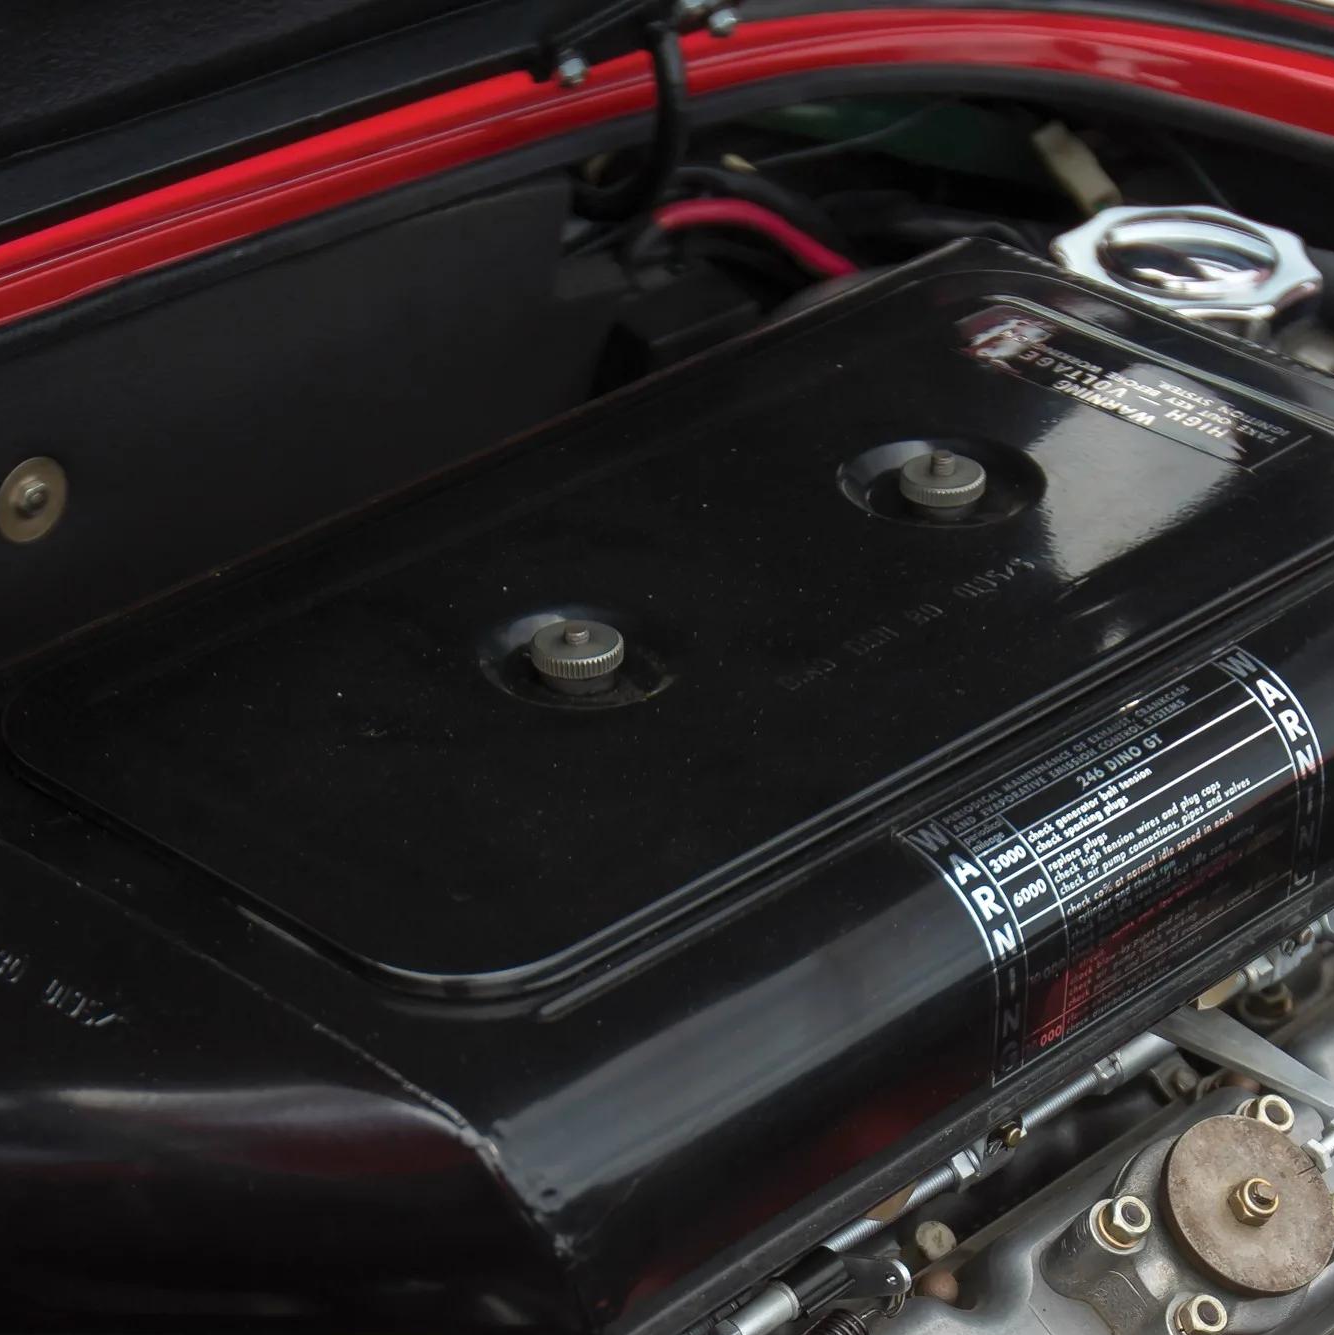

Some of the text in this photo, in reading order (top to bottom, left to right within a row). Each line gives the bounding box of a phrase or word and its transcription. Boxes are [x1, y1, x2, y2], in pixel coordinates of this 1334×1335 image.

[1019, 350, 1127, 397] VOLTAGE
[1104, 371, 1161, 397] BEFORE
[1052, 379, 1156, 426] WARNING
[1163, 398, 1195, 410] KEY
[1164, 409, 1228, 438] HIGH
[1197, 410, 1231, 424] OUT
[1217, 405, 1290, 436] IGNITION
[1236, 424, 1277, 443] TAKE
[941, 787, 1002, 826] PERIODICAL
[1002, 748, 1072, 792] MAINTENANCE
[1071, 741, 1087, 753] OF
[1133, 684, 1190, 717] CRANKCASE
[952, 698, 1186, 832] AND EVAPORATIVE EMISSION CONTROL SYSTEMS
[1073, 732, 1165, 788] 246 DINO GT
[1024, 765, 1153, 843] check generator belt tension
[1032, 792, 1131, 853] check sparking plugs
[961, 817, 1005, 845] periodical
[970, 830, 1007, 854] mileage
[1044, 829, 1109, 873] replace plugs
[1051, 780, 1222, 883] check high tension wires and plug caps
[1057, 872, 1085, 895] check
[1085, 864, 1100, 879] air
[1100, 851, 1127, 872] pump
[1179, 803, 1205, 825] pipes
[1203, 790, 1222, 808] and
[1222, 774, 1250, 797] valves
[1065, 893, 1091, 916] check
[1114, 875, 1124, 887] at
[1125, 854, 1156, 880] normal
[1157, 843, 1174, 861] idle
[1175, 827, 1202, 851] speed
[1202, 822, 1211, 834] in
[1213, 808, 1233, 827] each
[1077, 894, 1112, 924] cylinder
[1114, 883, 1131, 901] and
[1133, 867, 1156, 889] check
[1159, 859, 1176, 877] rpm
